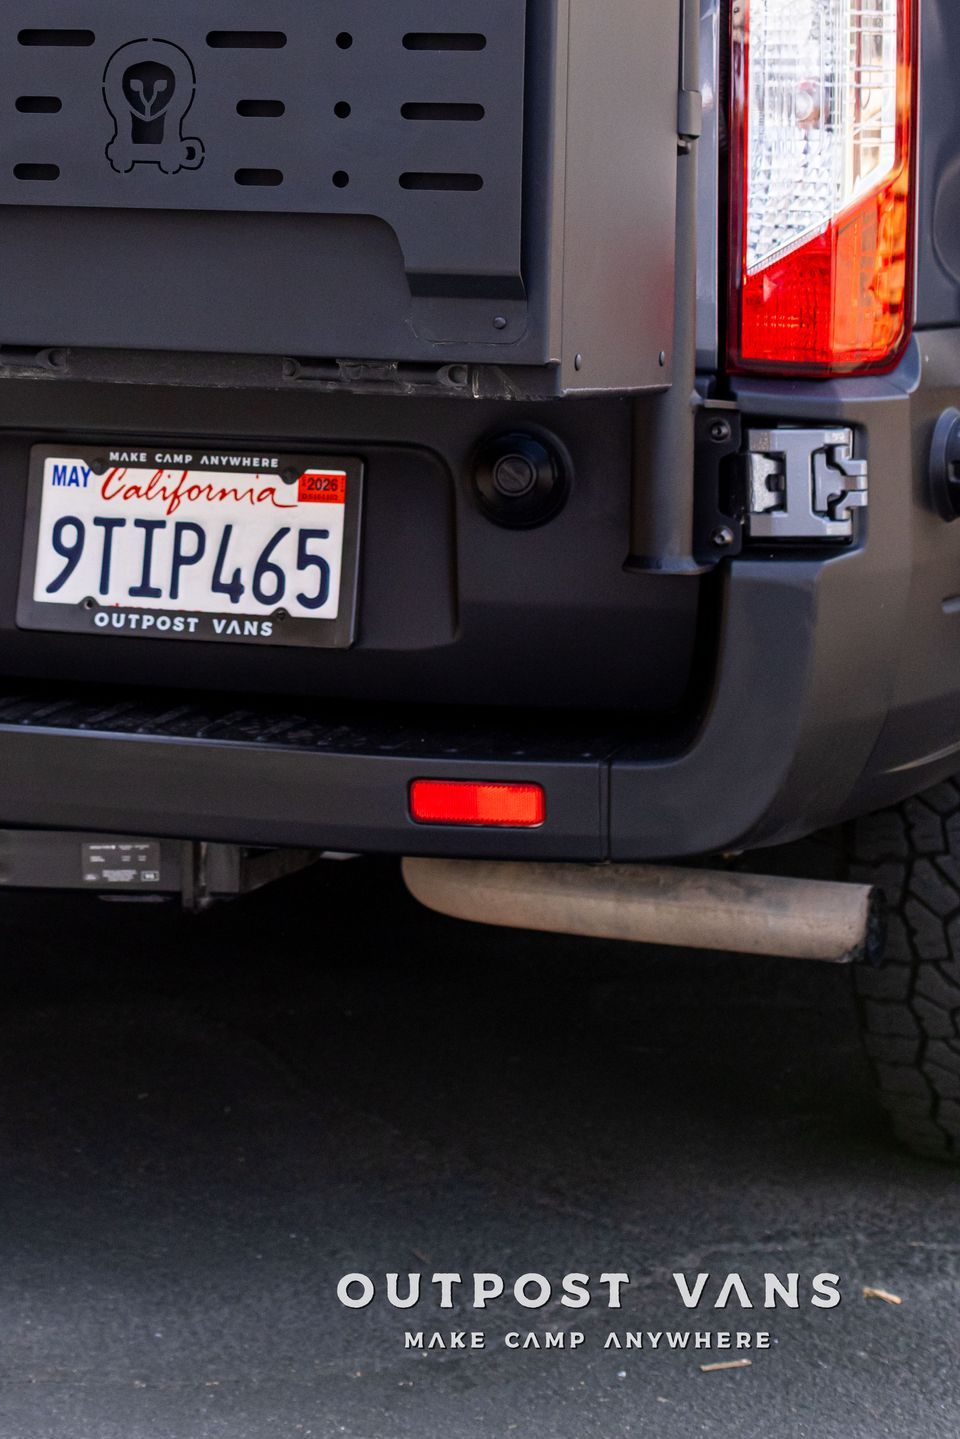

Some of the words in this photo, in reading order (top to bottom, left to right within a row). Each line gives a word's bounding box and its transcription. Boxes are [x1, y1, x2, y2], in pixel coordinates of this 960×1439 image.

[109, 451, 147, 462] MAKE
[155, 453, 193, 464] CAMP
[200, 455, 279, 468] ANYWHERE
[51, 464, 91, 488] MAY
[101, 467, 298, 516] California
[307, 477, 339, 492] 2026
[45, 515, 331, 610] 9TIP465
[94, 612, 199, 633] OUTPOST
[213, 619, 274, 637] VANS
